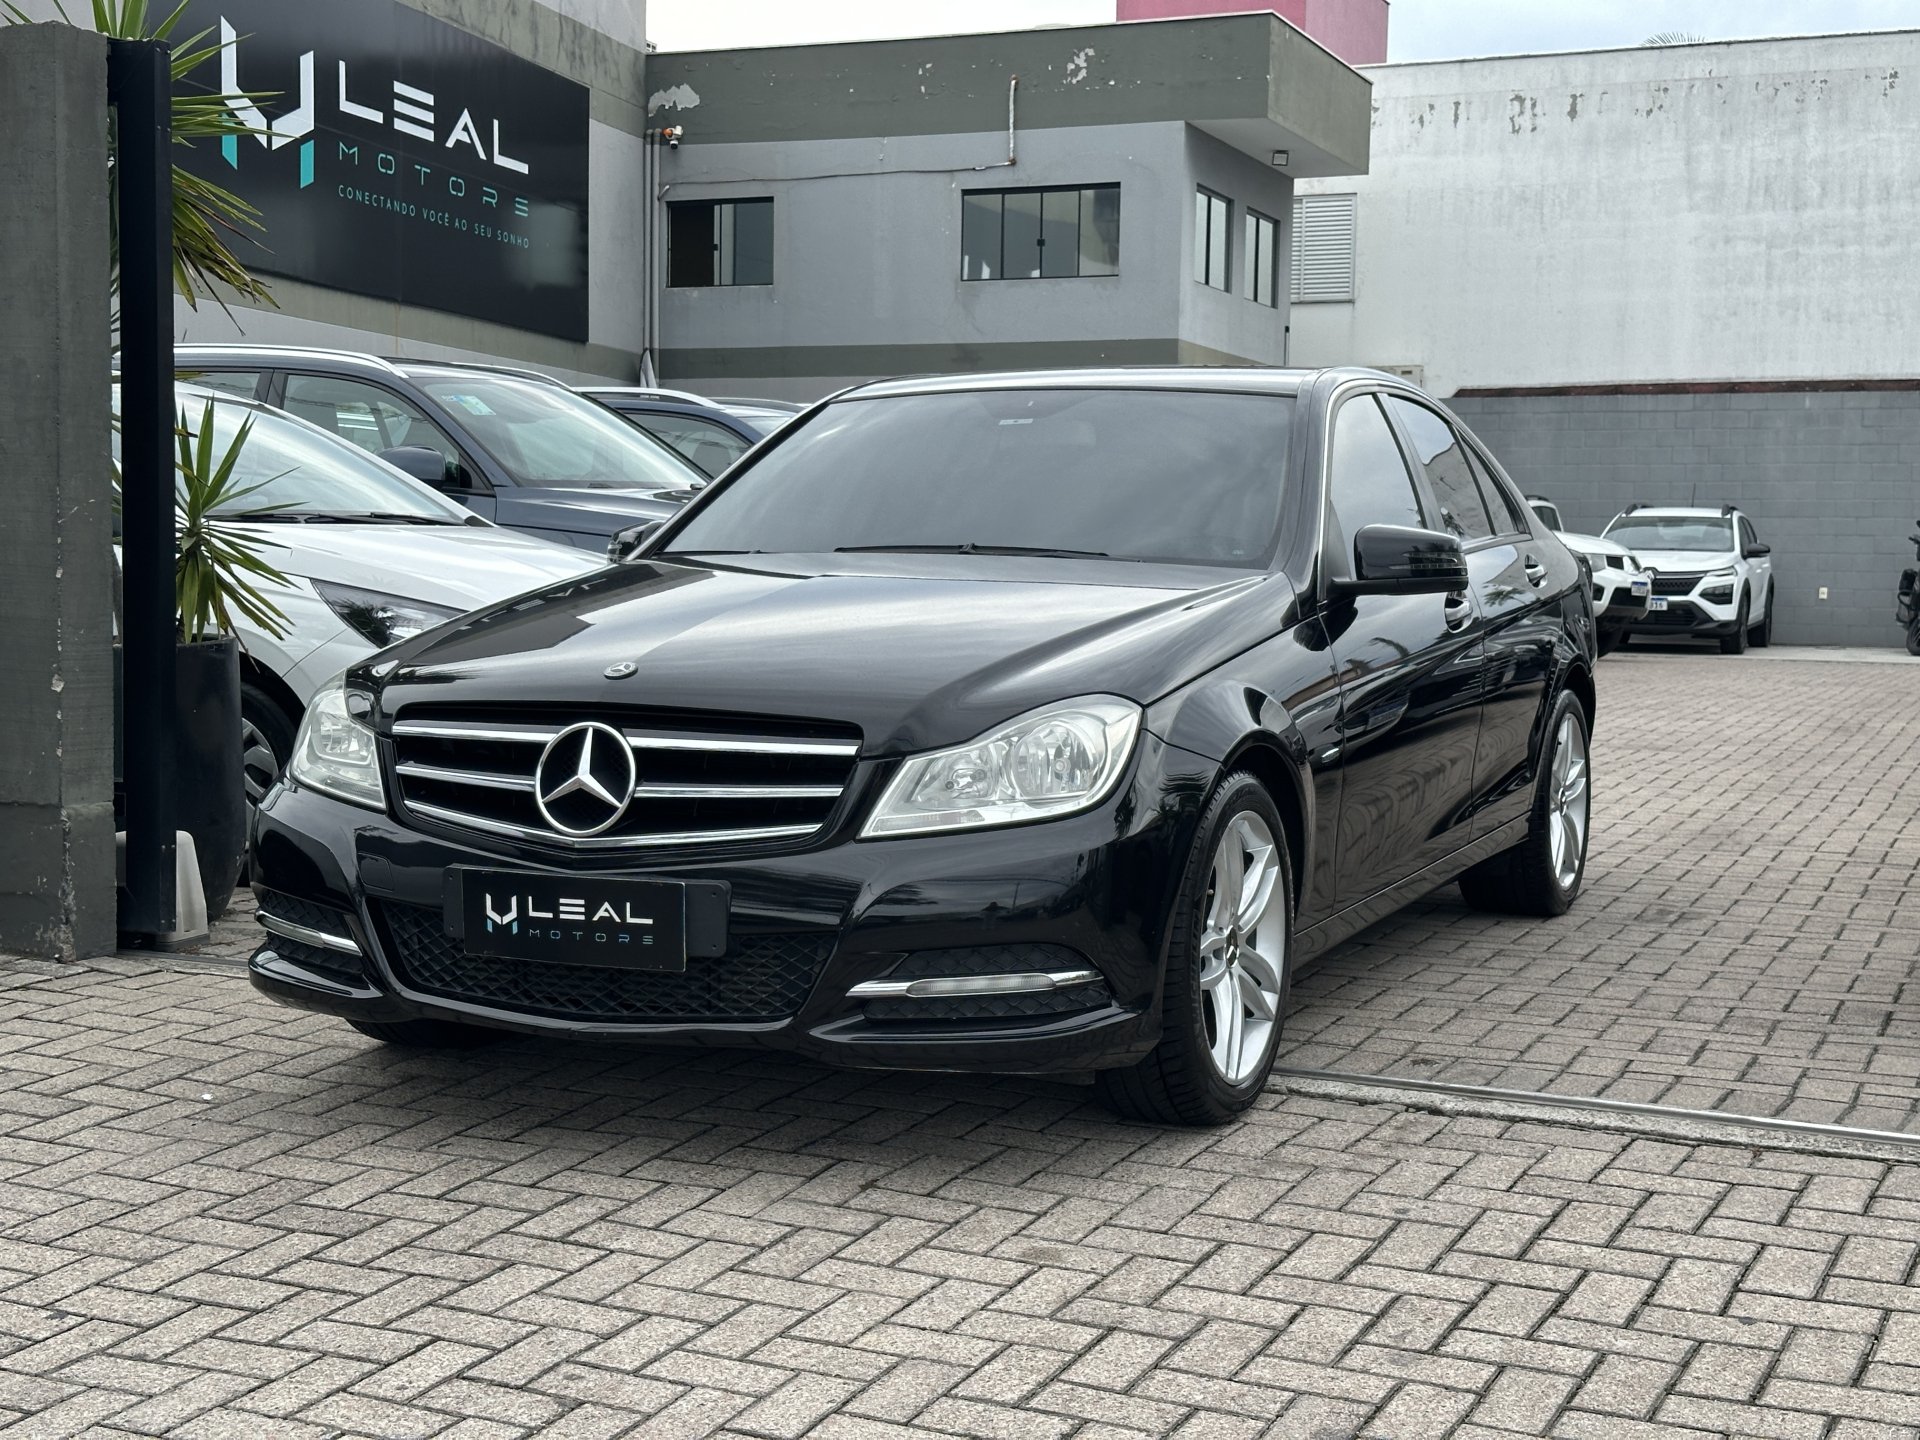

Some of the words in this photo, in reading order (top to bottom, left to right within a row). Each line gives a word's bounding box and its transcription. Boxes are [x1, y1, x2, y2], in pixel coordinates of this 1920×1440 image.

[338, 59, 529, 175] LEAL
[338, 140, 529, 218] MOTORS
[338, 184, 416, 217] CONECTANDO
[422, 207, 449, 226] VOCÊ
[454, 218, 468, 231] AO
[474, 223, 492, 238] SEU
[497, 230, 529, 249] SONHO
[528, 895, 654, 925] LEAL
[529, 928, 654, 945] MOTORS
